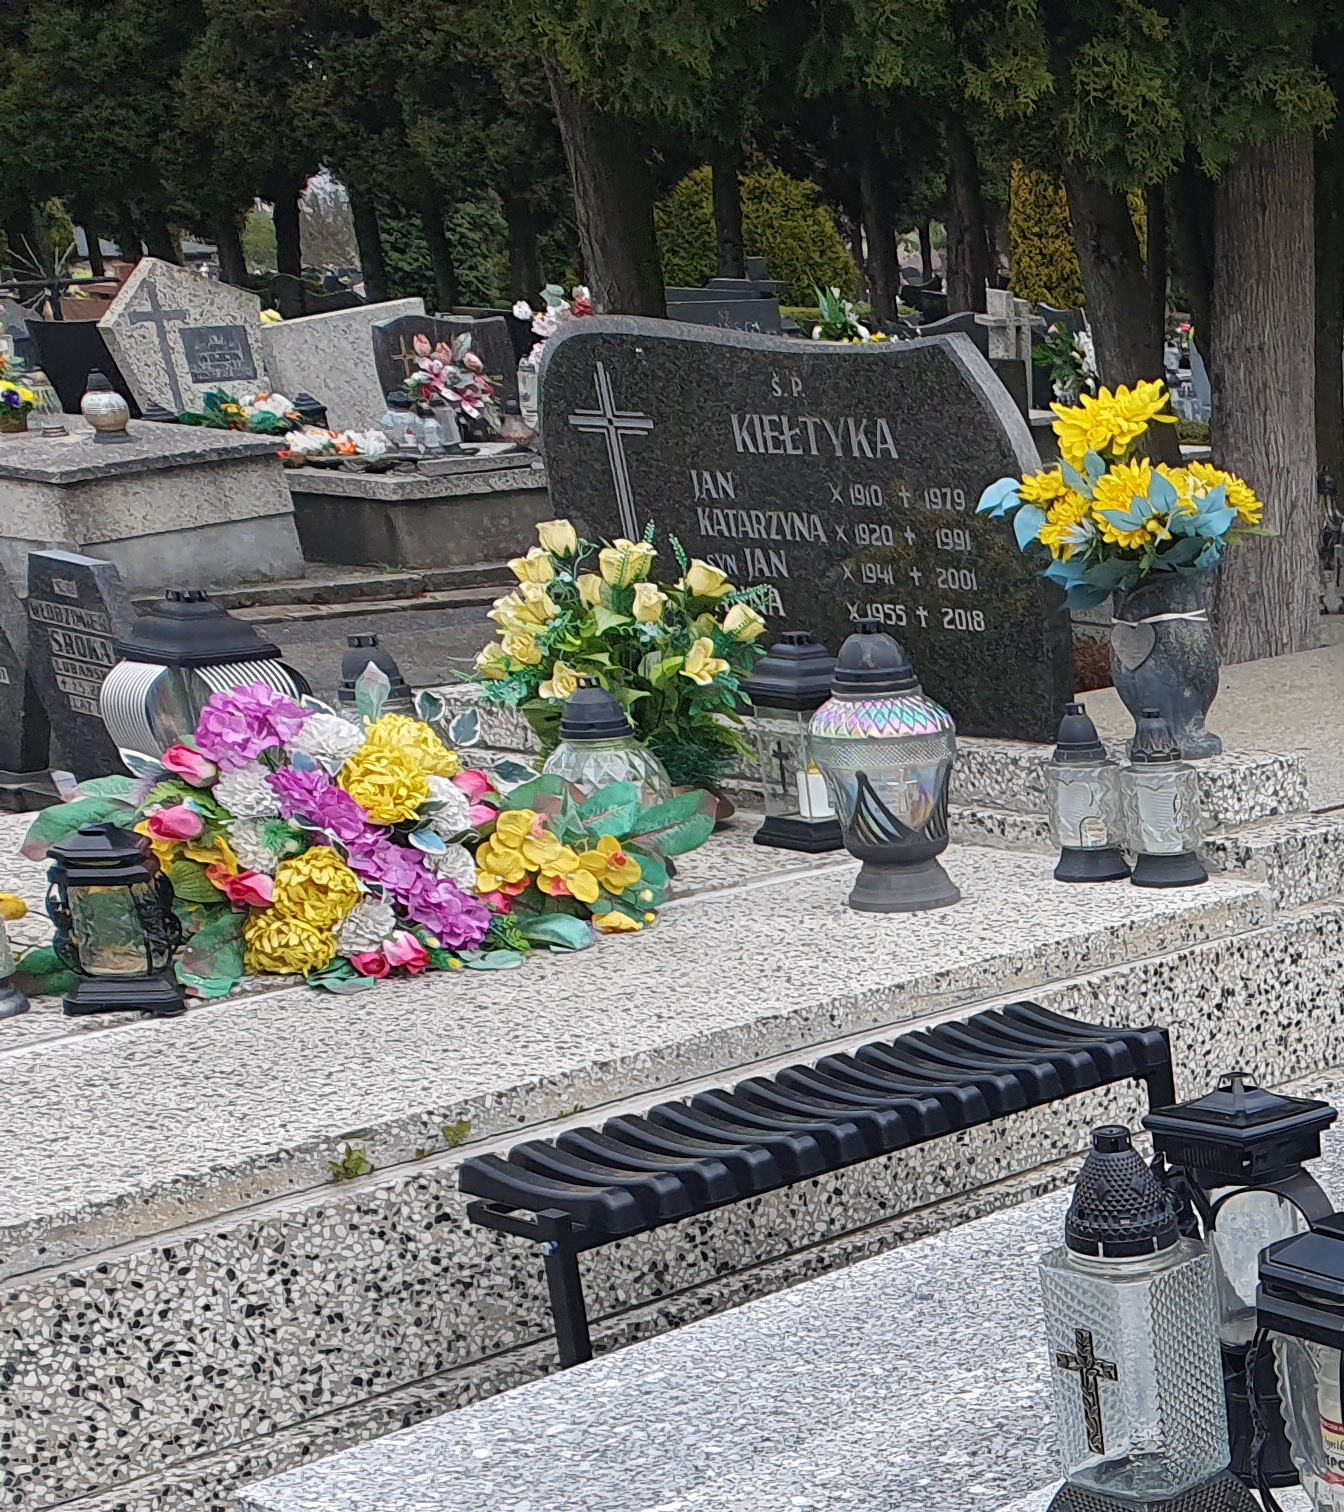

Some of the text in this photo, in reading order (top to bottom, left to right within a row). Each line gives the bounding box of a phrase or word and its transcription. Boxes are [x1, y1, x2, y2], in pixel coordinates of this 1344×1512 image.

[729, 412, 900, 460] KIEŁTYKA
[689, 468, 736, 502] JAN
[849, 482, 883, 508] 1910
[922, 486, 966, 512] 1979
[695, 506, 832, 544] KATARZYNA
[854, 522, 894, 547] 1920
[935, 527, 973, 552] 1991
[742, 546, 791, 582] JAN
[860, 562, 896, 586] 1941
[935, 566, 978, 592] 2001
[866, 602, 908, 627] 1955
[941, 606, 987, 633] 2018
